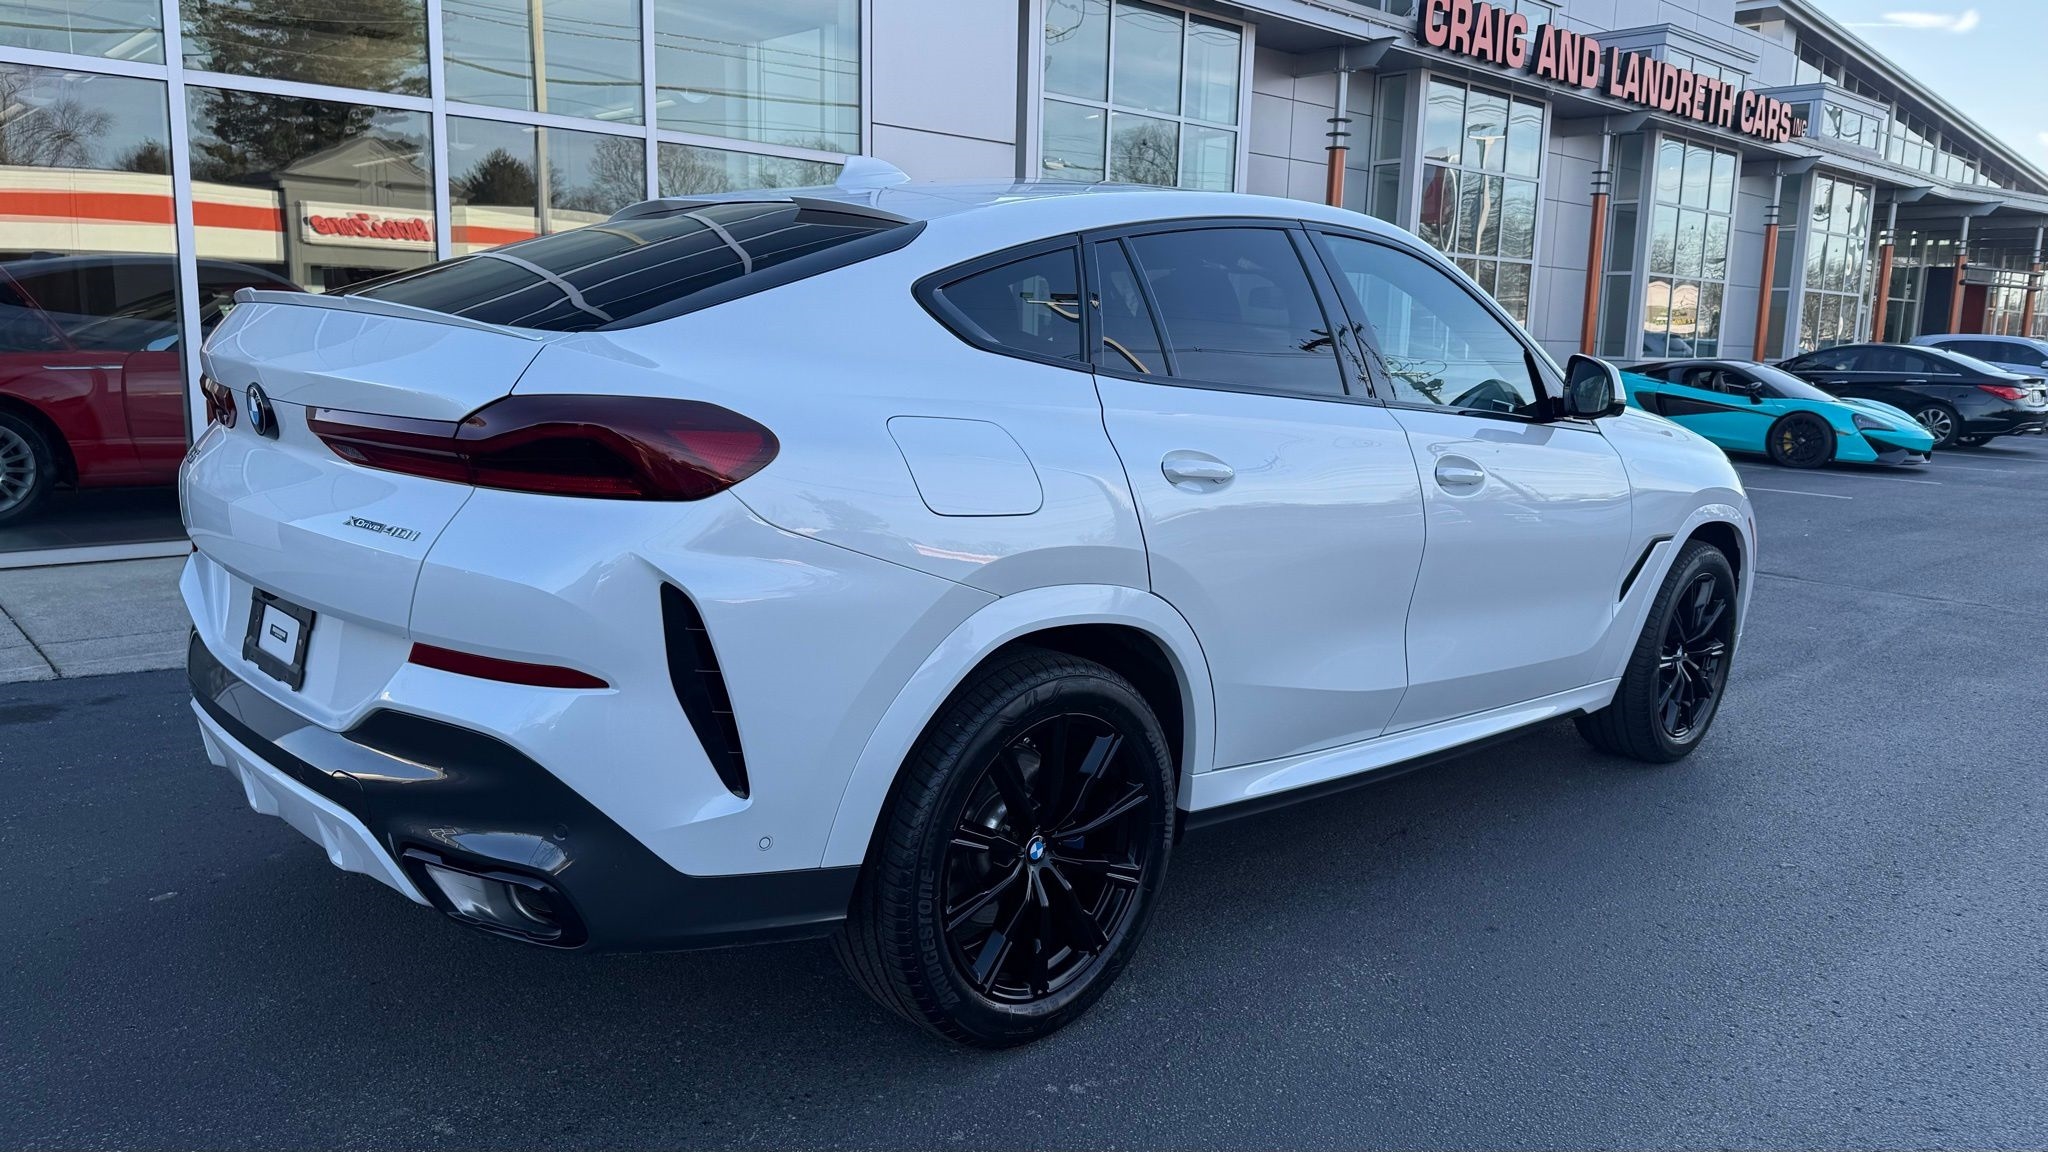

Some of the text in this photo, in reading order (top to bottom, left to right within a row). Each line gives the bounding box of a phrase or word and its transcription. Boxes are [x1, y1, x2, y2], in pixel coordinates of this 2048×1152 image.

[1424, 0, 1528, 69] CRAIG
[1536, 23, 1601, 89] AND
[1609, 45, 1736, 128] LANDRETH
[1740, 90, 1792, 143] CARS
